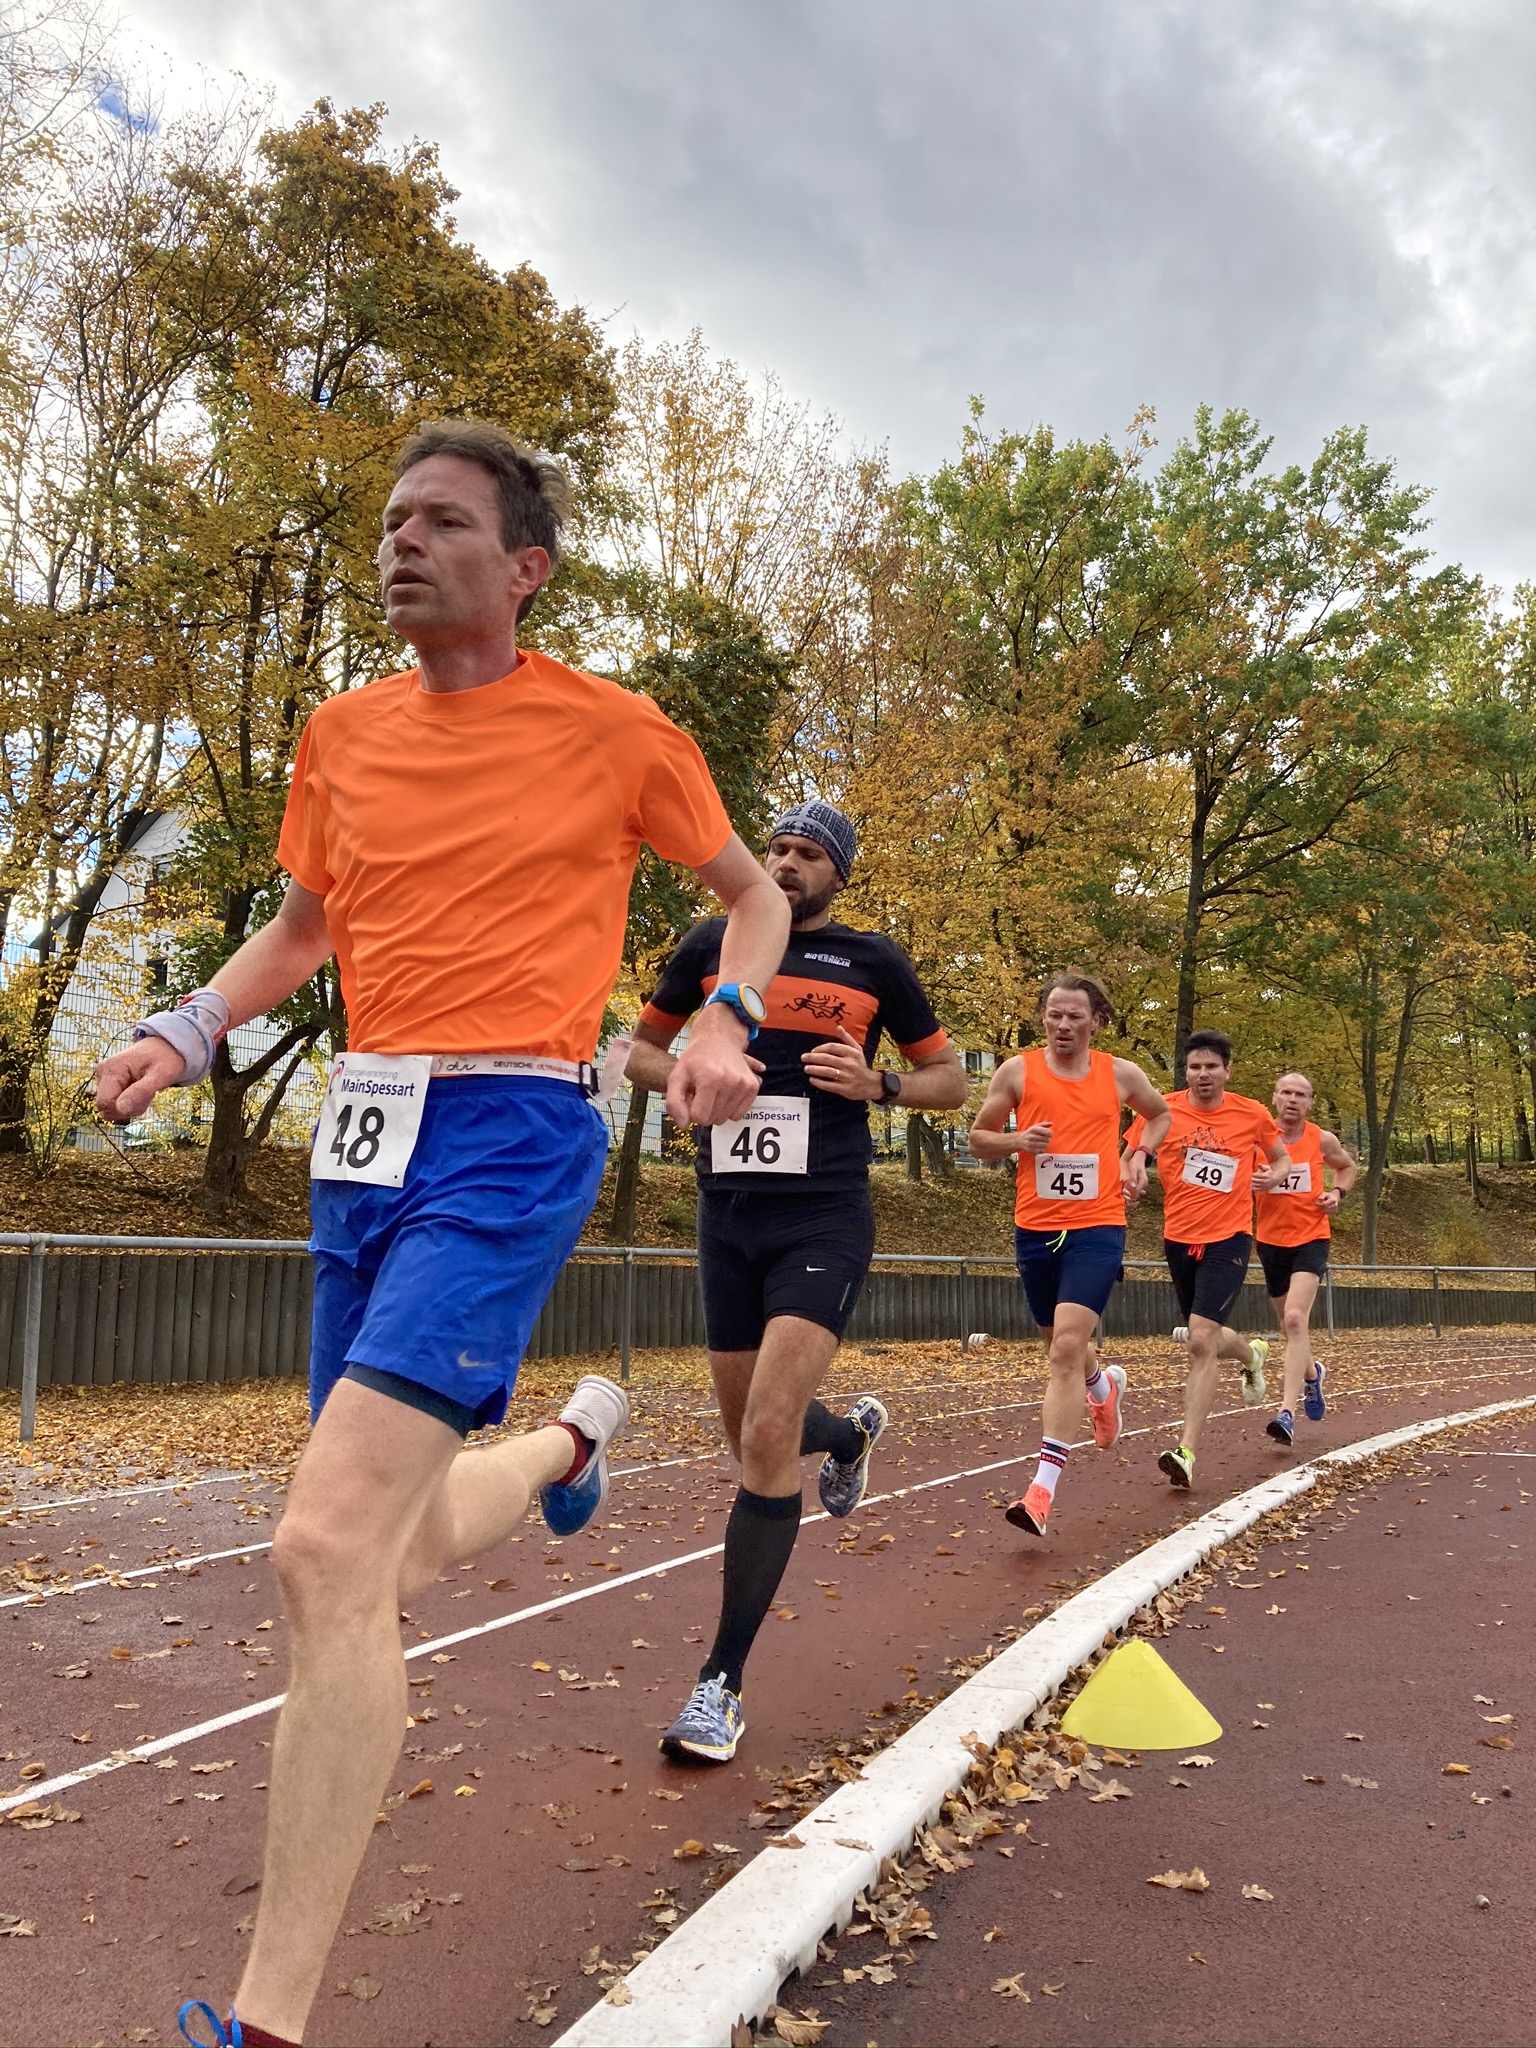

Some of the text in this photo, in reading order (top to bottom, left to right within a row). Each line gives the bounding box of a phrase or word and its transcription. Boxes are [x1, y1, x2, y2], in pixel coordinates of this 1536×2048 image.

[493, 1060, 533, 1069] DEUTSCHE
[341, 1078, 415, 1097] MainSpessart
[742, 1111, 801, 1122] ainSpessart
[330, 1104, 385, 1169] 48
[730, 1126, 781, 1165] 46
[1050, 1172, 1084, 1196] 45
[1195, 1165, 1223, 1187] 49
[1278, 1175, 1301, 1190] 47
